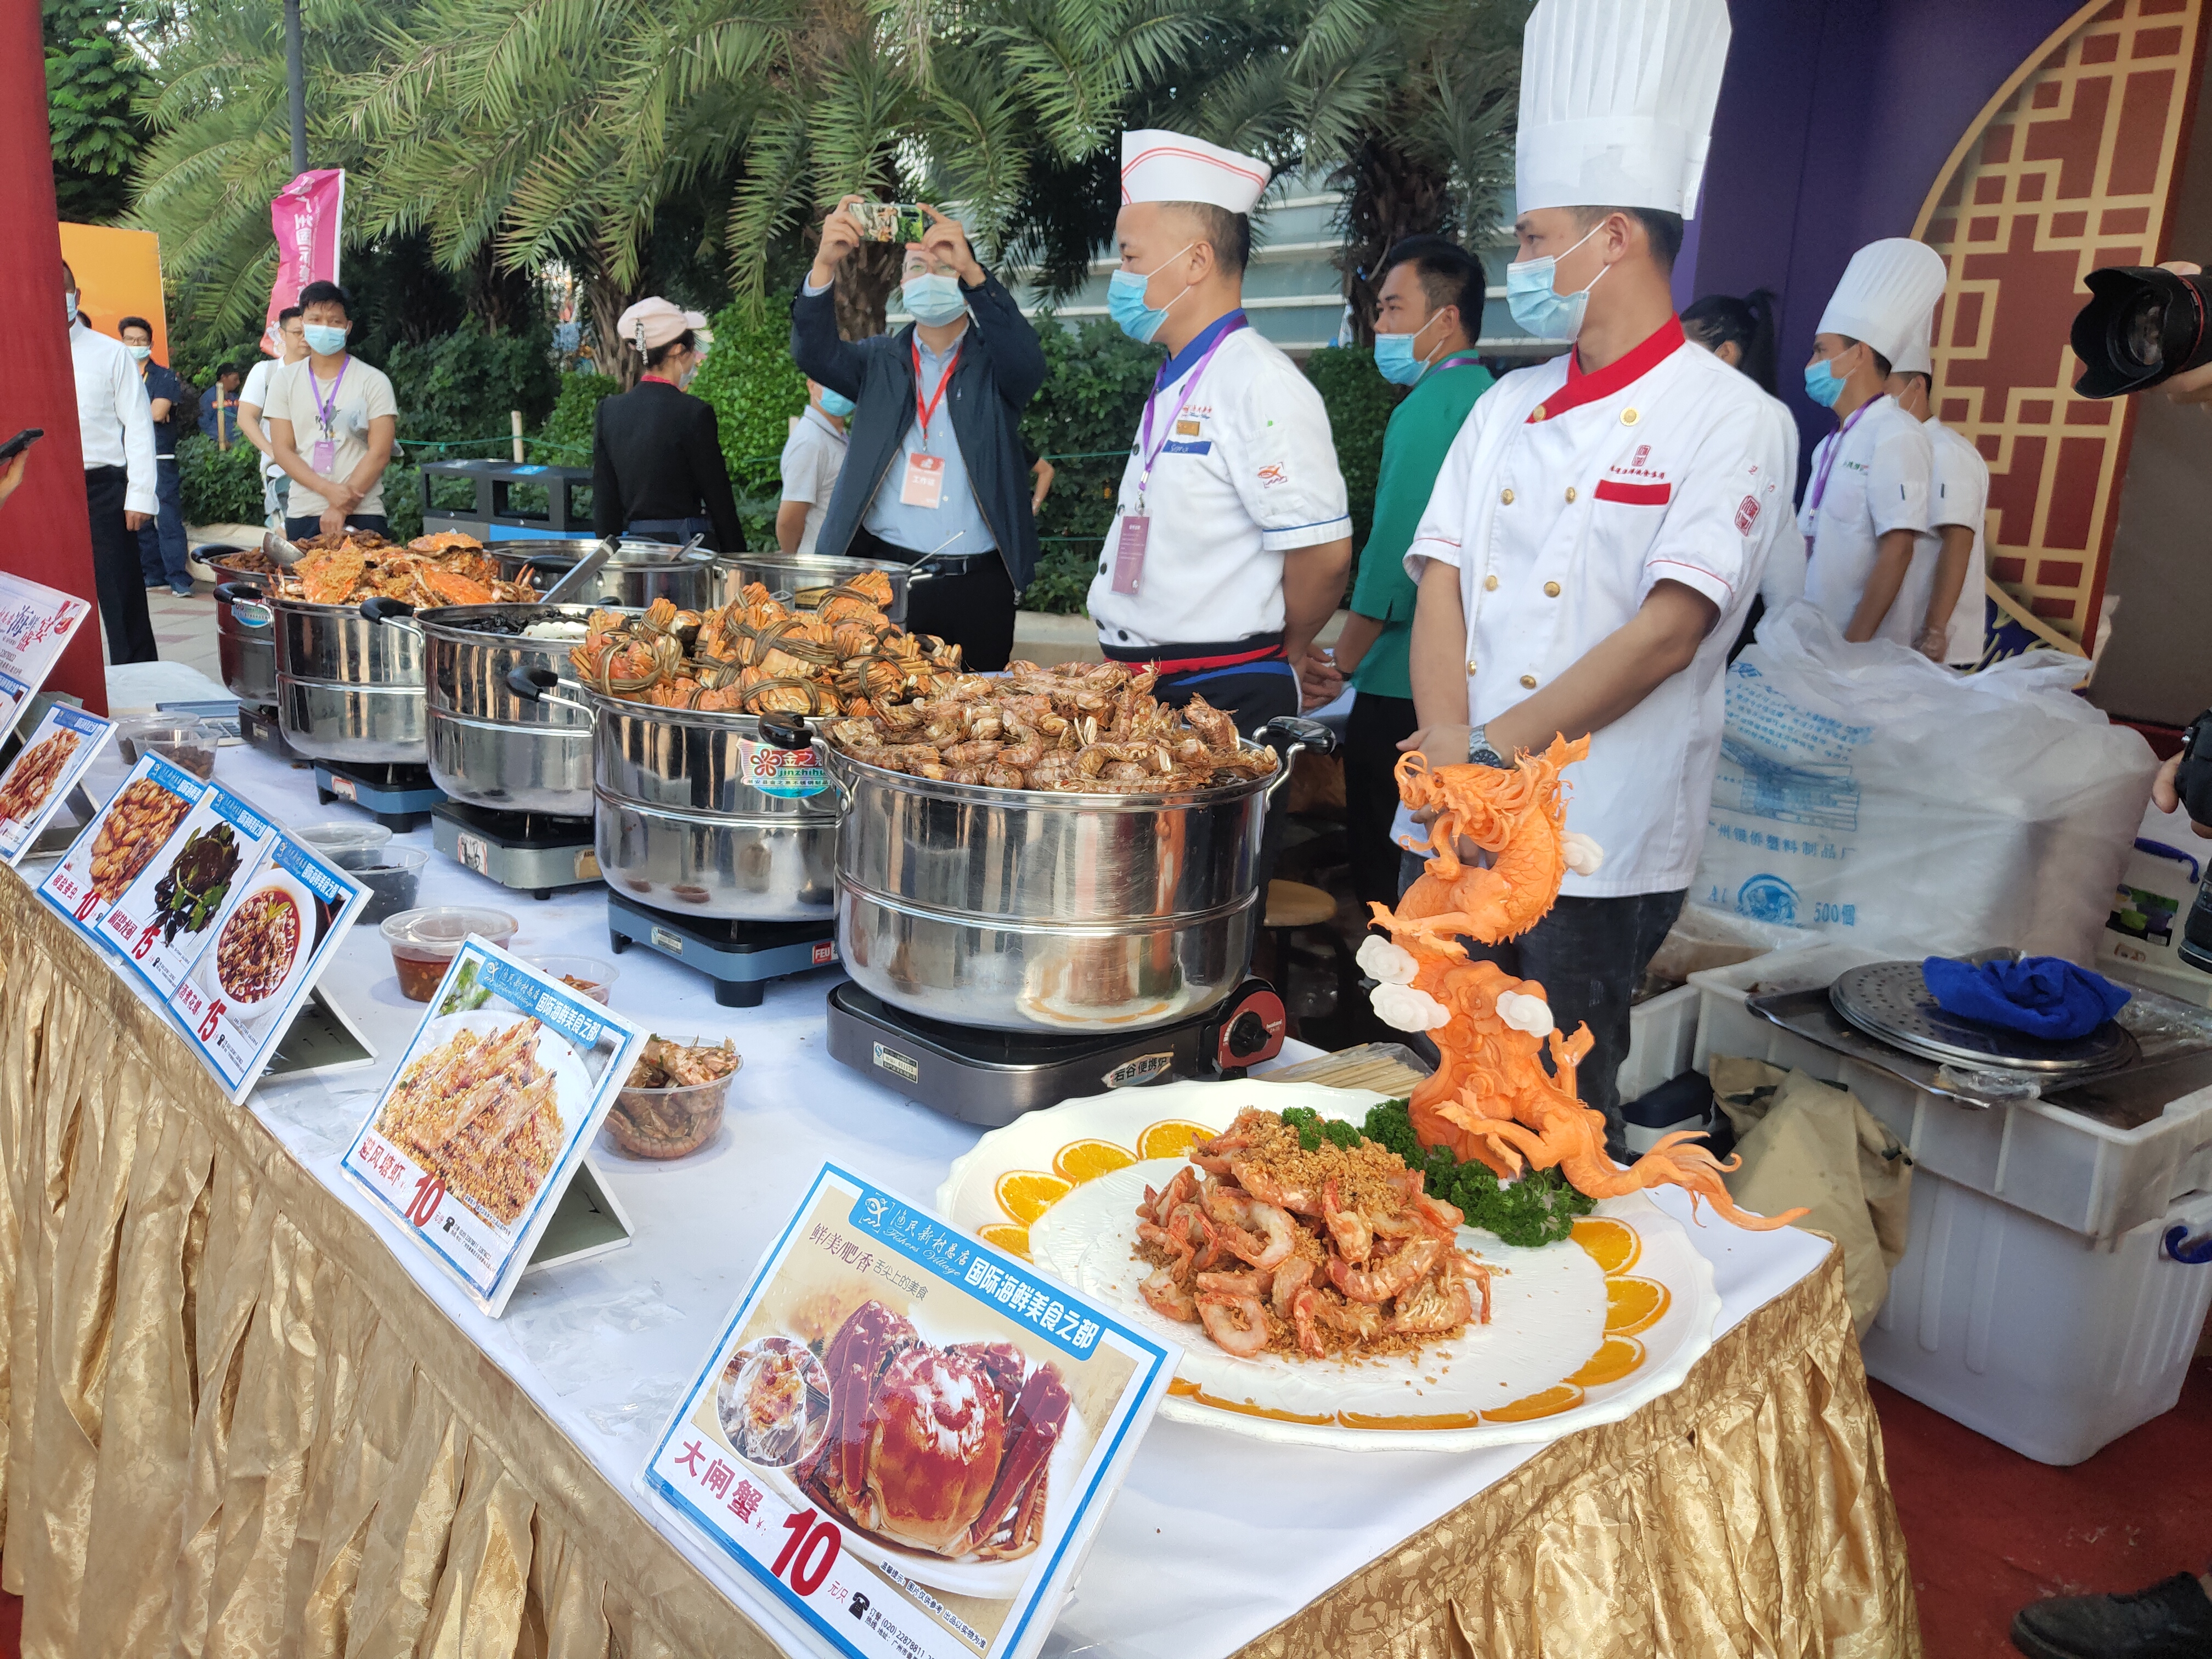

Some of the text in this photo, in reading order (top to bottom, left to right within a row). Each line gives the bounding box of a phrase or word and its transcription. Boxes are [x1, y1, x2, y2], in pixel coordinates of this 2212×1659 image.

[72, 889, 101, 922] 10
[131, 924, 162, 960] 15
[198, 997, 227, 1042] 15
[534, 992, 602, 1042] 国际海鲜美食之都
[404, 1172, 446, 1227] 10
[883, 1227, 962, 1277] Fishers Village
[872, 1260, 929, 1302] 舌尖上的美食
[963, 1255, 1100, 1350] 国际海鲜美食之都
[674, 1440, 764, 1524] 大闸蟹
[770, 1507, 842, 1597] 10
[827, 1581, 849, 1604] 元/只
[906, 1581, 944, 1614] 图片仅供参考
[943, 1611, 988, 1649] 出品以实物为准
[896, 1630, 925, 1658] 22878811
